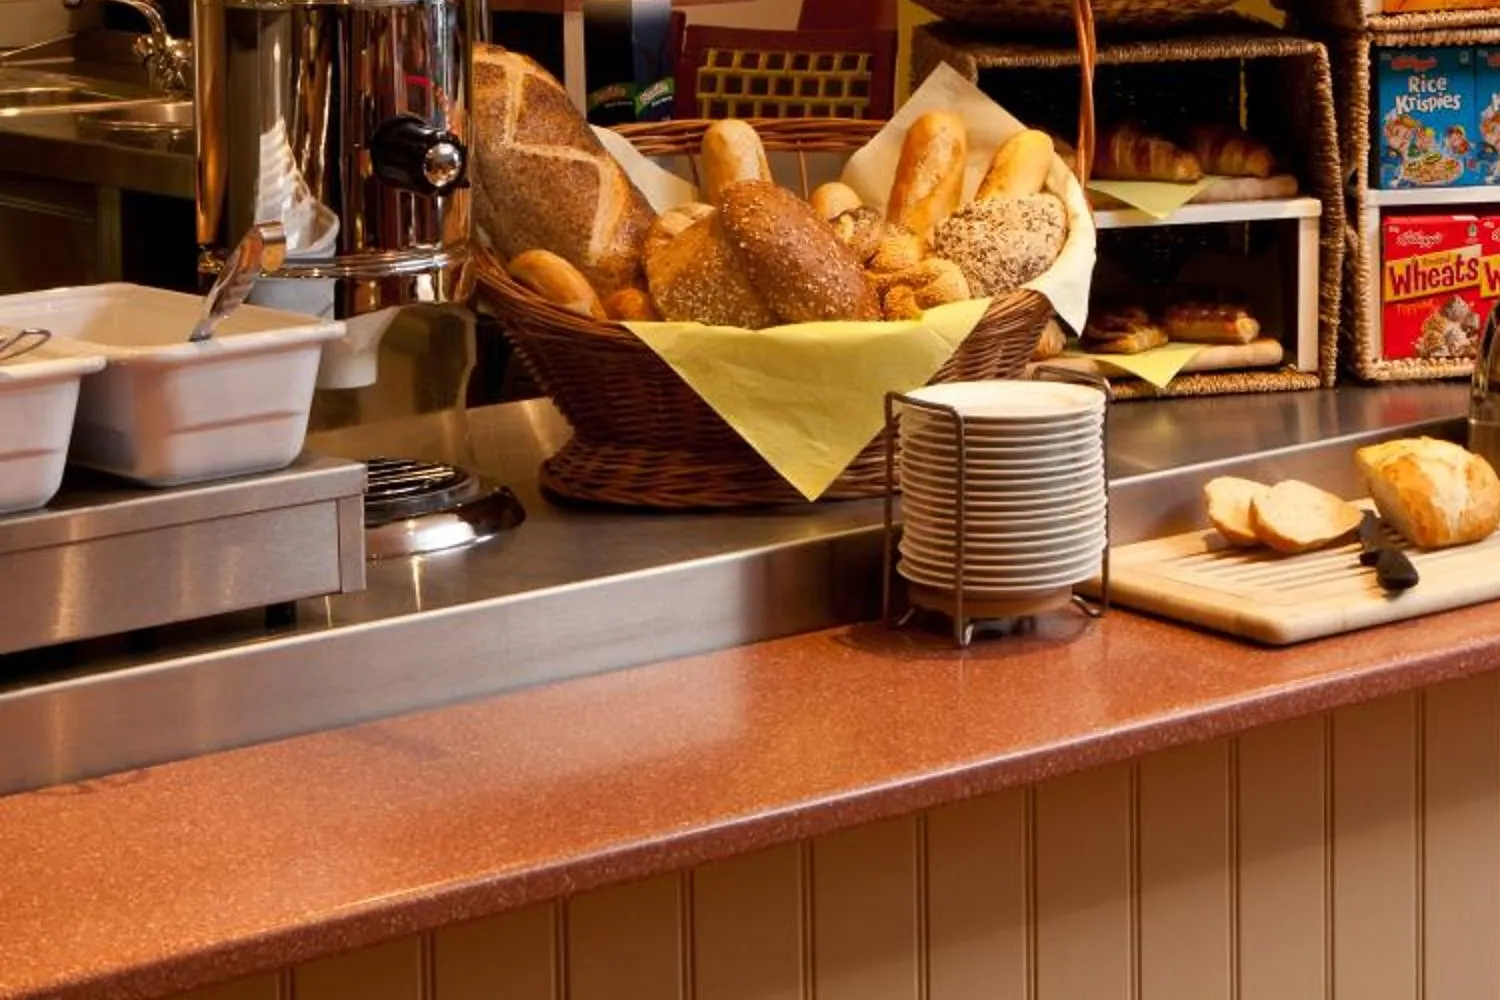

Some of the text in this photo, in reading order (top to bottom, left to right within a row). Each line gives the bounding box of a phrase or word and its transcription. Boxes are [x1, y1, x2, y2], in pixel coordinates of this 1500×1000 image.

[1408, 73, 1447, 93] Rice
[1395, 91, 1461, 114] Krispies
[1389, 254, 1479, 296] Wheats
